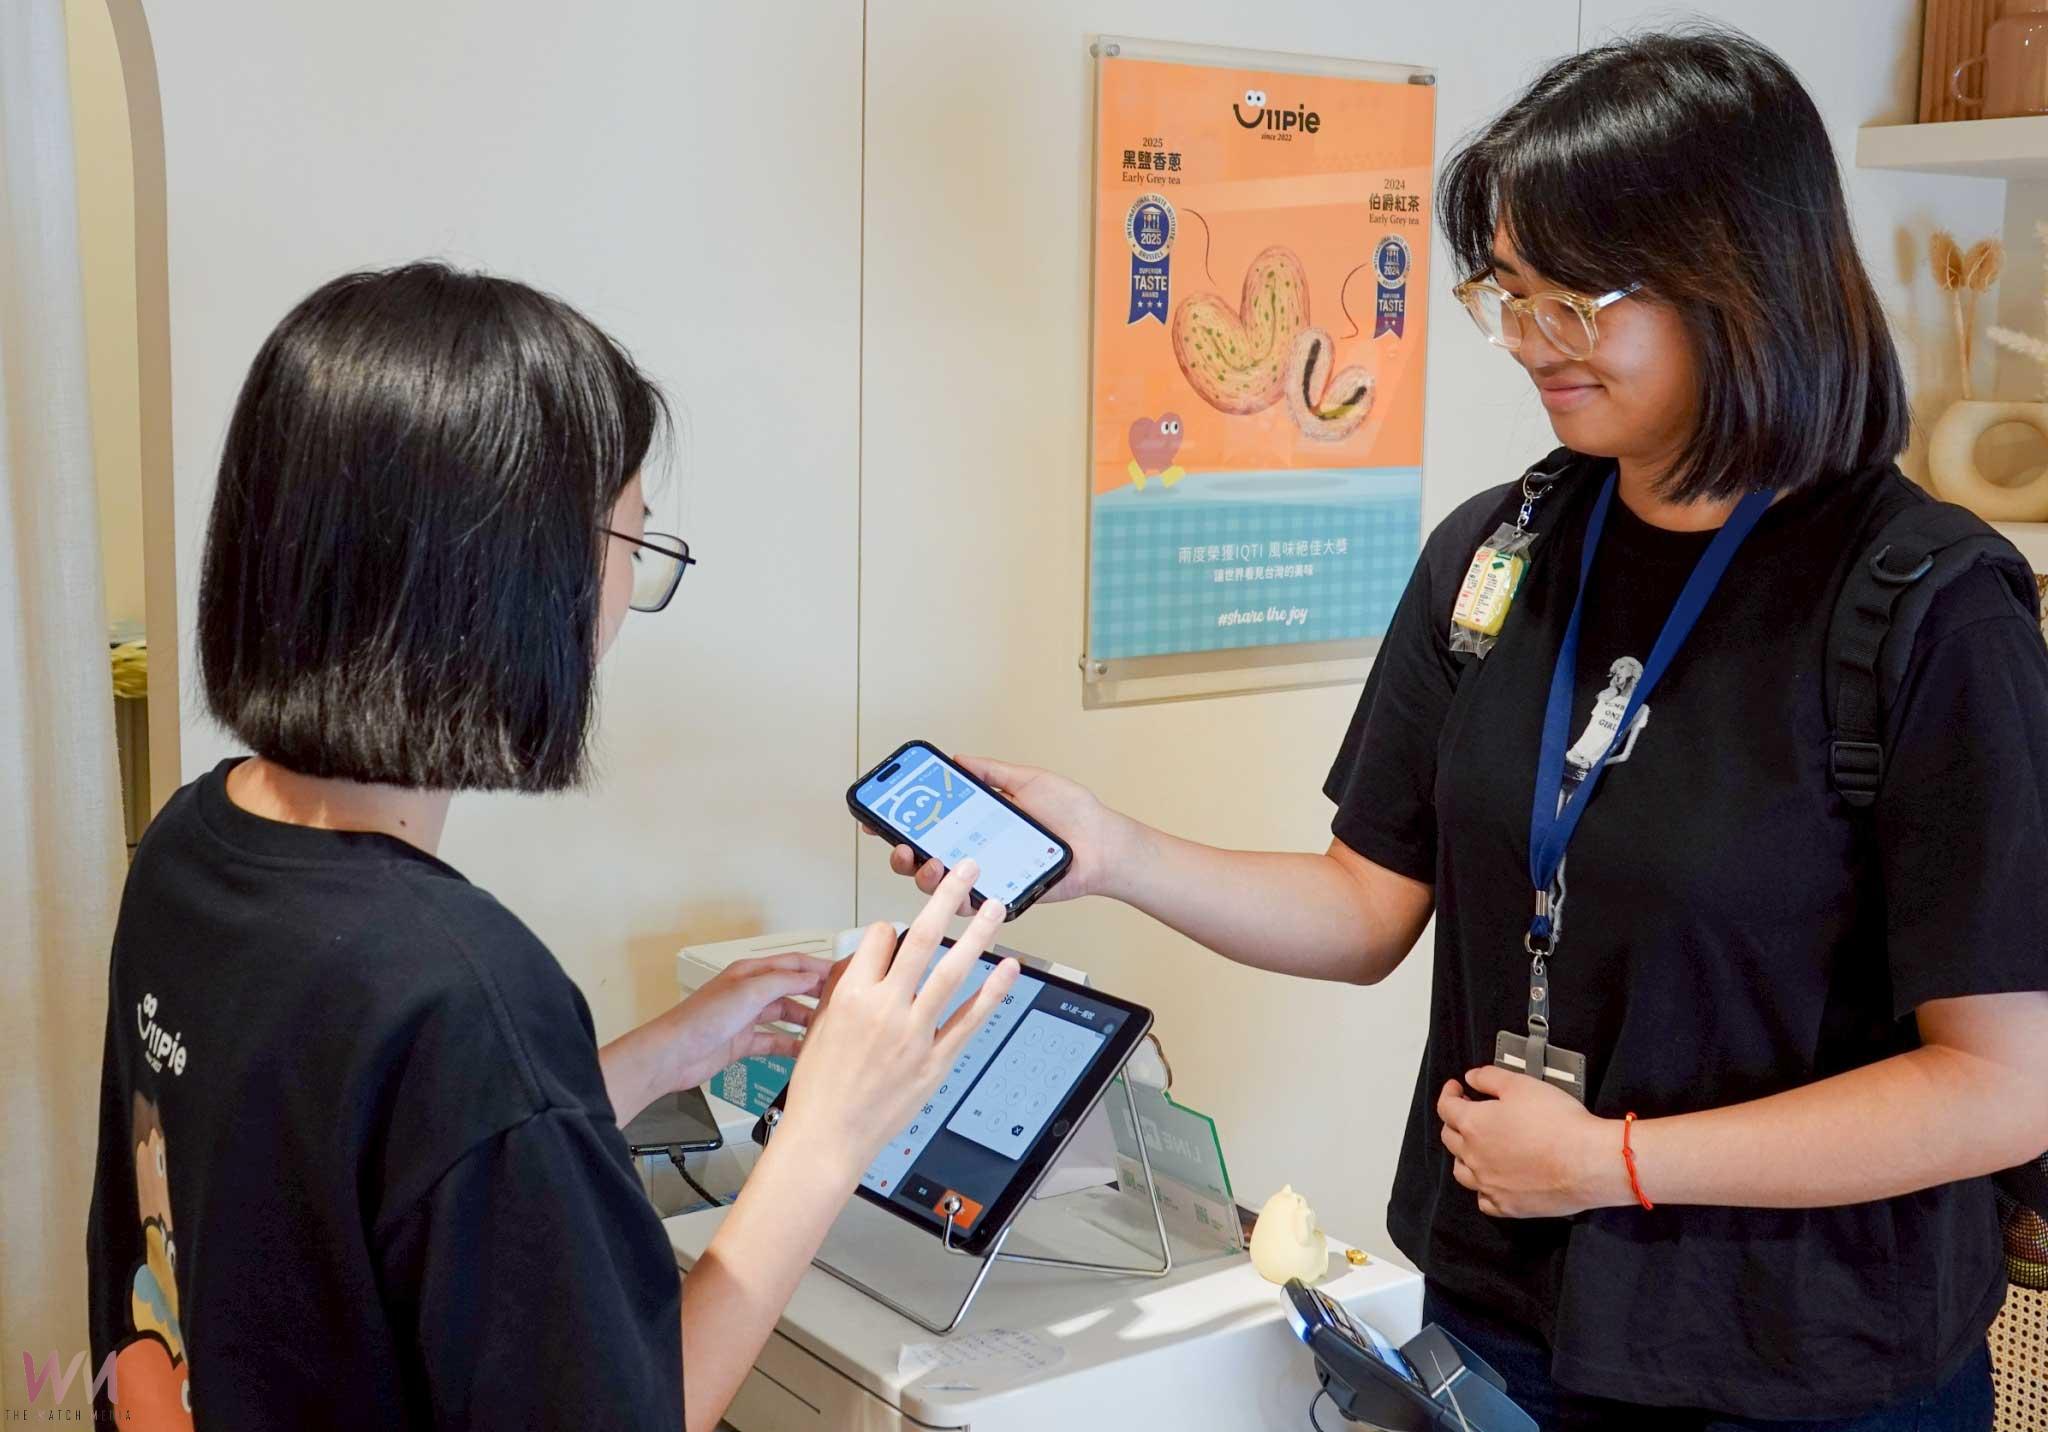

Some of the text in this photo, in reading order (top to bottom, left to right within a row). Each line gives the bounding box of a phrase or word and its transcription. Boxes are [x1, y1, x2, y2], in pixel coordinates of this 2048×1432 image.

[1142, 137, 1164, 148] 2025
[1122, 171, 1181, 187] Early Grey tea
[1384, 178, 1406, 190] 2024
[1369, 192, 1420, 213] 伯爵紅茶
[1140, 233, 1162, 245] 2025
[1133, 275, 1168, 291] TASTE
[1379, 299, 1405, 313] TASTE
[1266, 606, 1287, 622] the
[1285, 604, 1309, 627] joy
